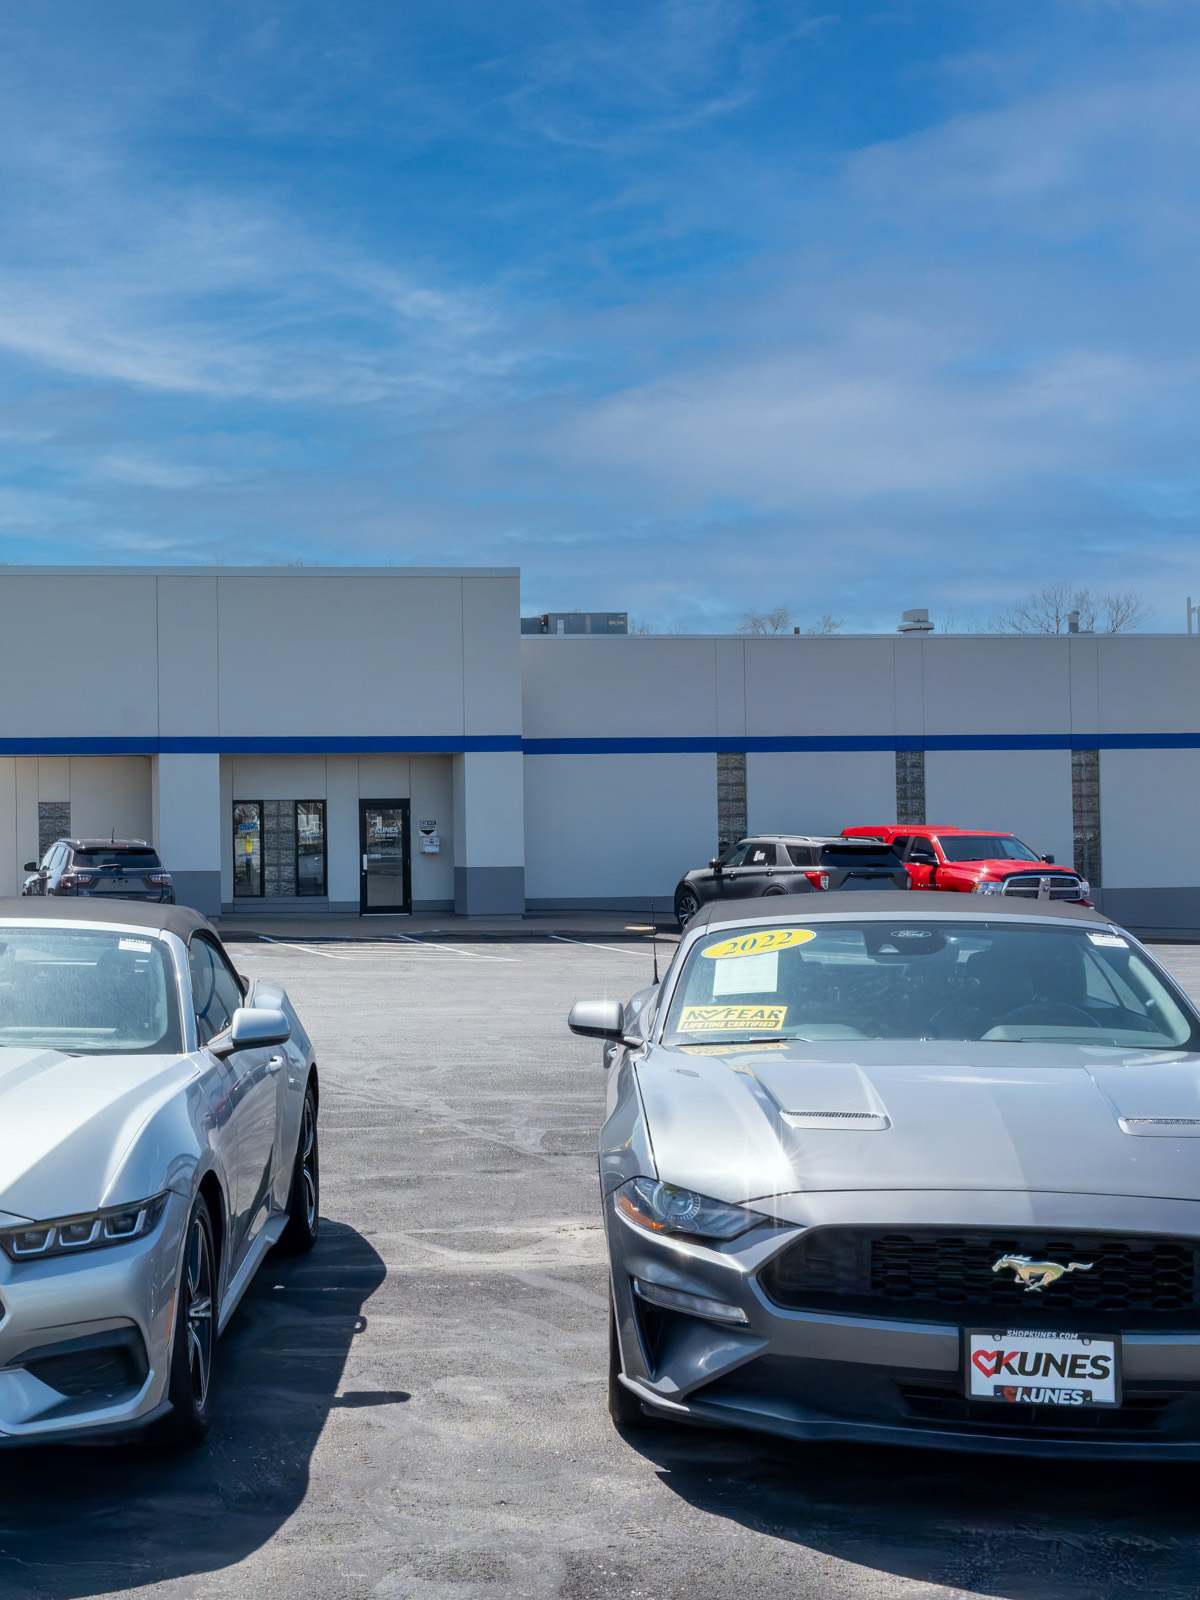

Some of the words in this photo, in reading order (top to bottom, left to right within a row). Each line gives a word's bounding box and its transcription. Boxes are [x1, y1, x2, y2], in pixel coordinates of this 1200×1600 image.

[723, 931, 793, 956] 2022
[725, 1009, 783, 1019] FEAR
[684, 1020, 726, 1029] LIFETIME
[727, 1020, 777, 1029] CERTIFIED
[1006, 1329, 1079, 1340] SHOPKUNES.COM
[994, 1350, 1112, 1380] KUNES
[1015, 1386, 1084, 1405] KUNES
